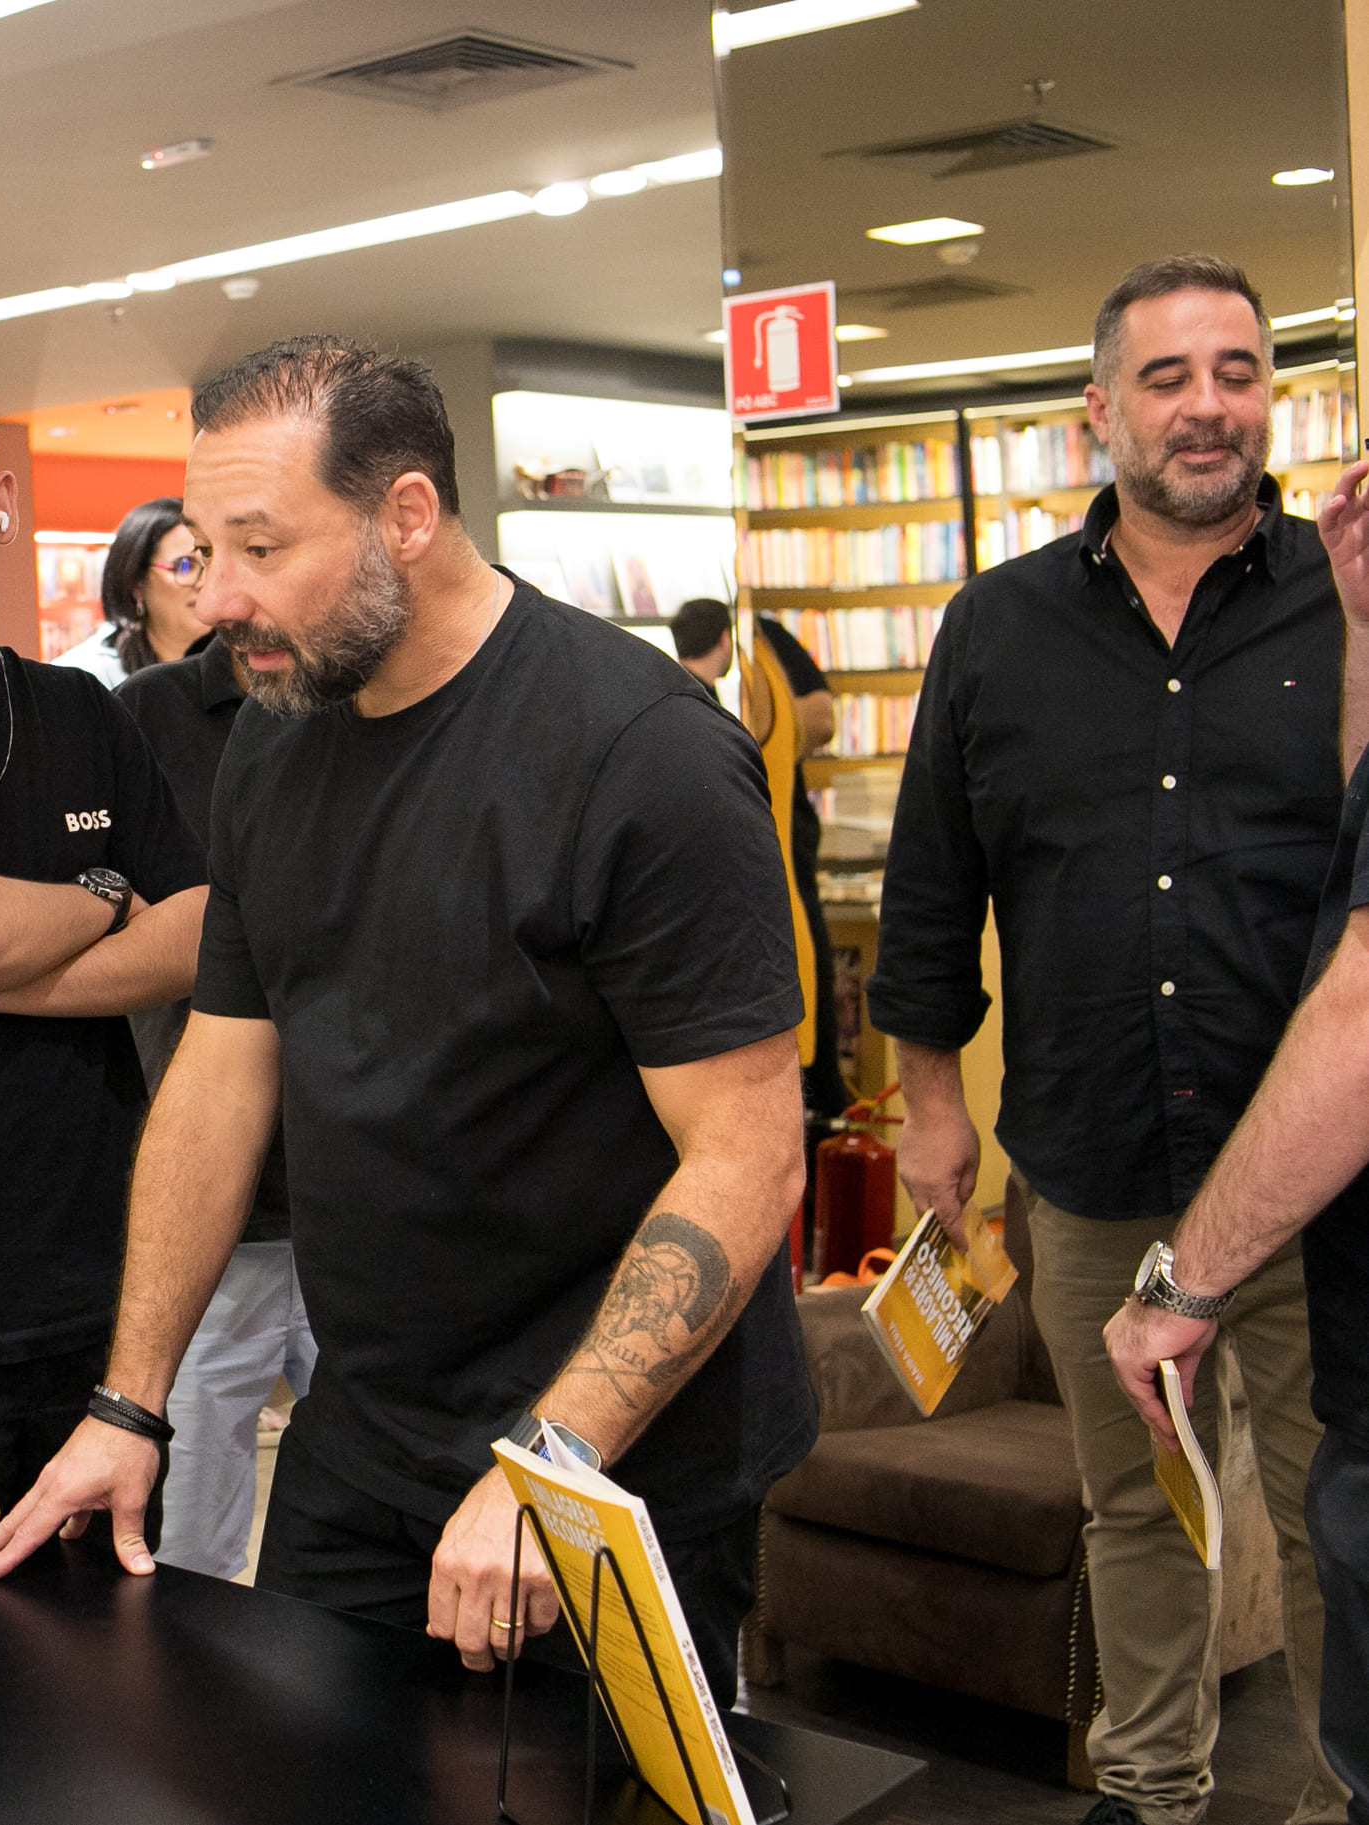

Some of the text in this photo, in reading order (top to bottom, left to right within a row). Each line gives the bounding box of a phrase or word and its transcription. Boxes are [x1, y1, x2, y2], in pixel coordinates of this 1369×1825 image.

[64, 809, 112, 832] BOSS
[911, 1275, 954, 1354] MILAGRE
[917, 1241, 974, 1344] RECOMEÇO
